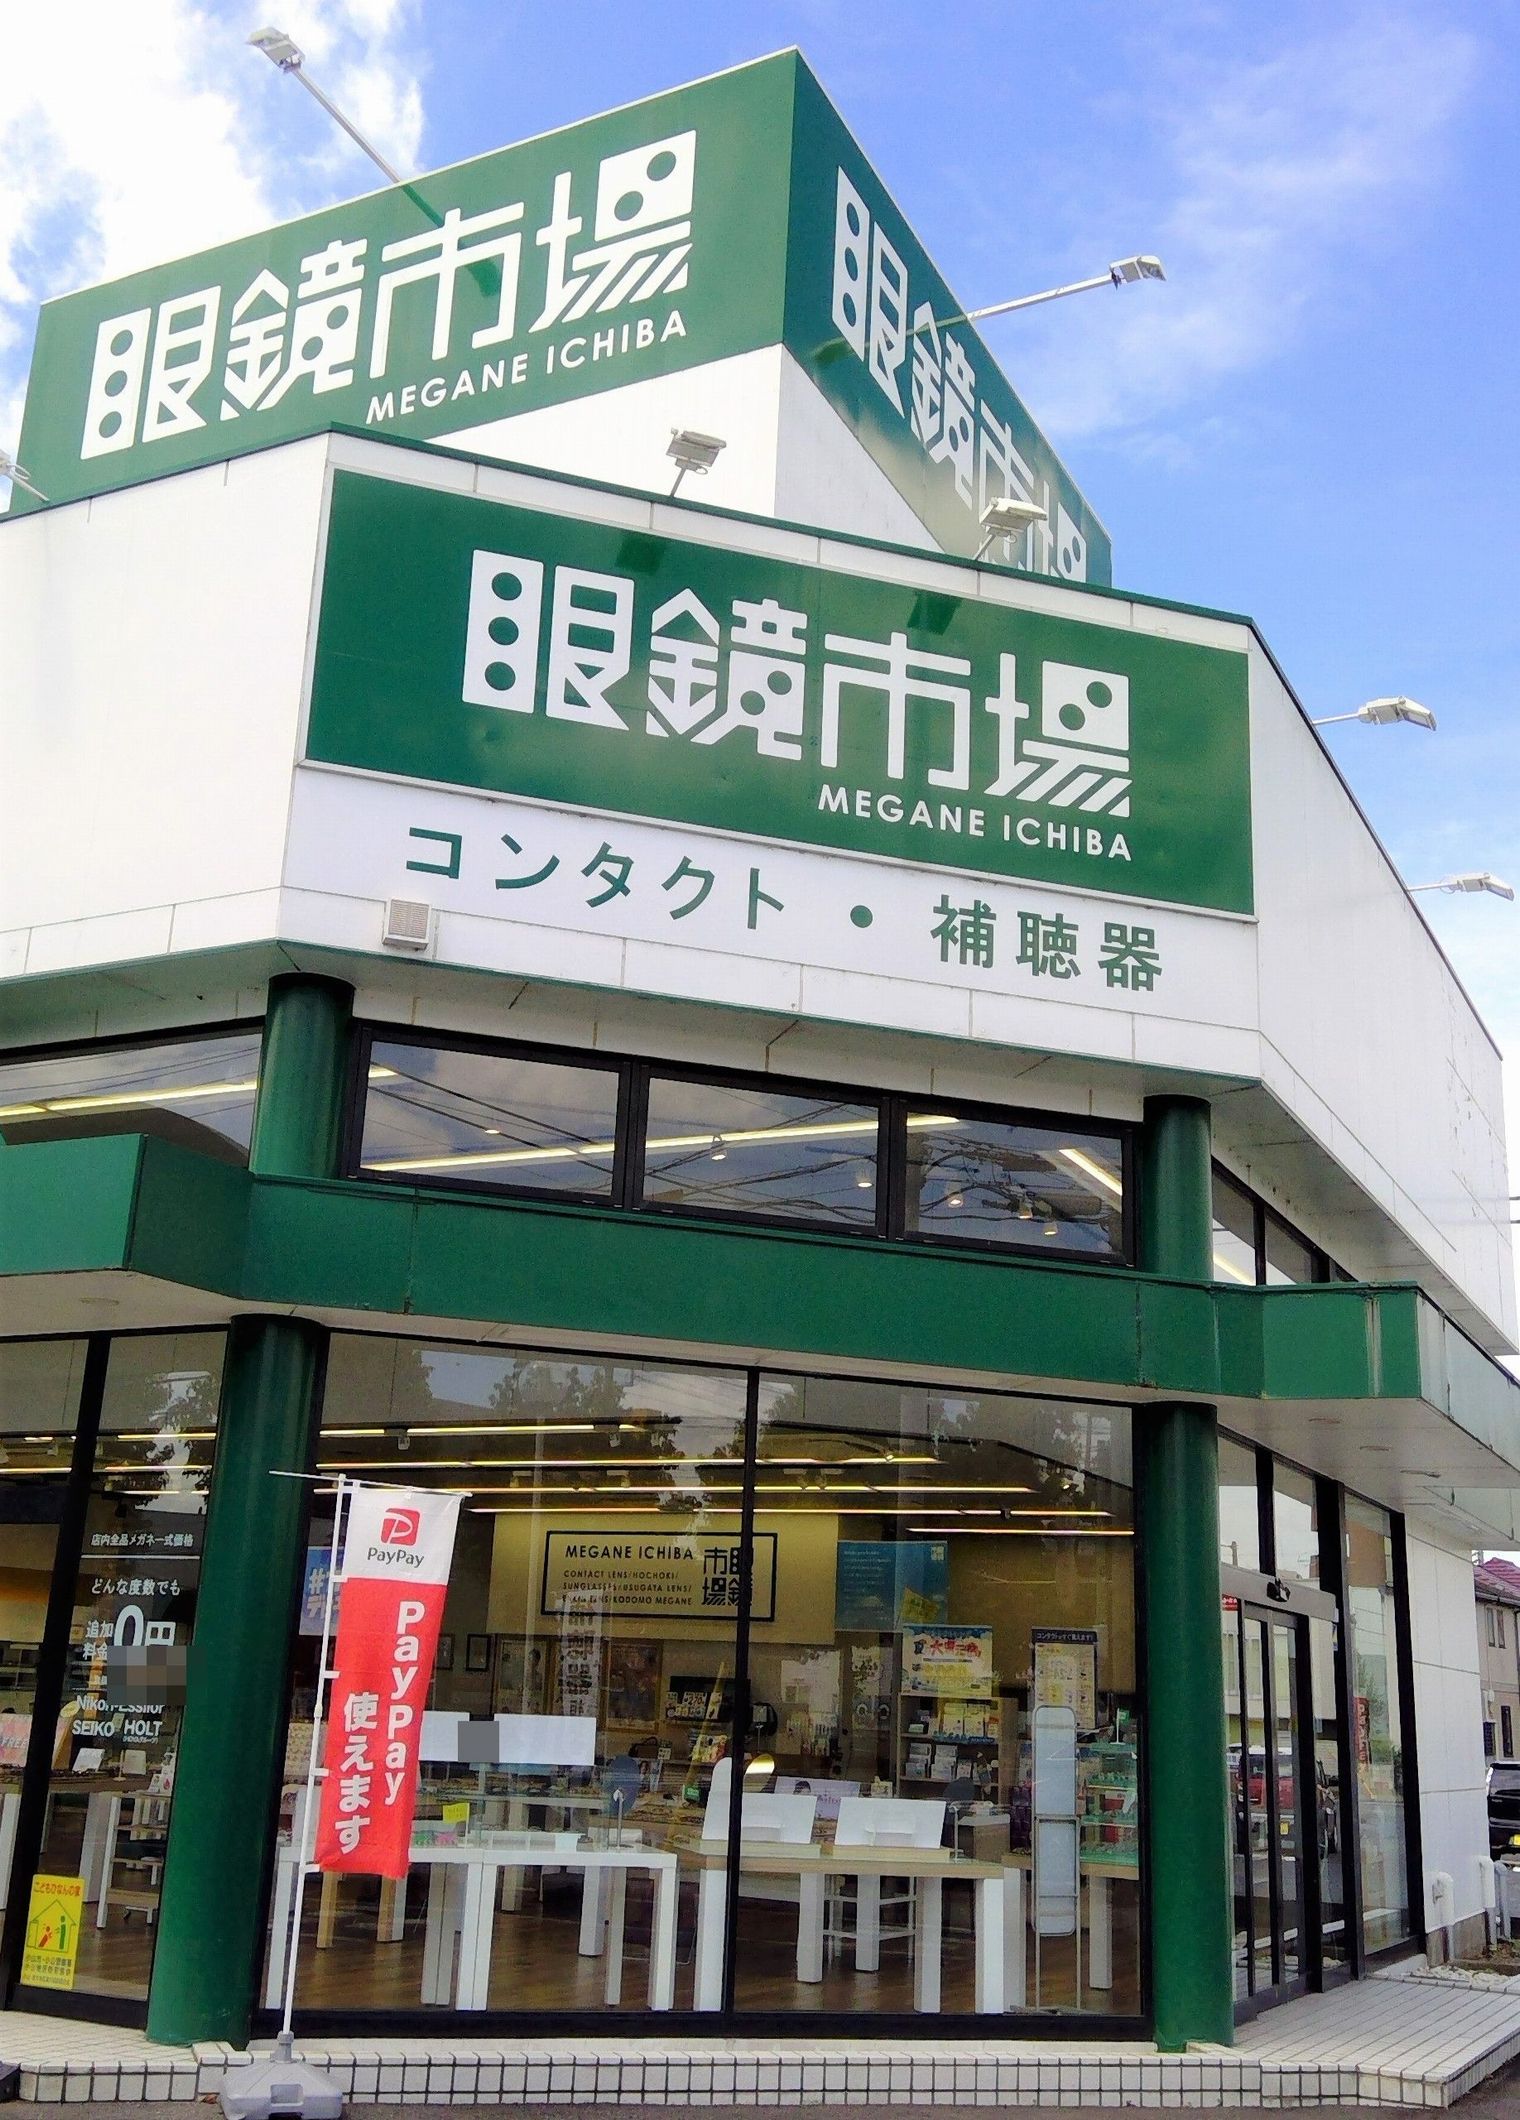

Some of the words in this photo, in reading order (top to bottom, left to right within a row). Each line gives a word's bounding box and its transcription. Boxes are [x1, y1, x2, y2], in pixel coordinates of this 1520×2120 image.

[80, 129, 697, 460] 眼鏡市場
[365, 353, 529, 425] MEGANE
[546, 310, 688, 375] ICHIBA
[461, 549, 1132, 818] 眼鏡市場
[817, 786, 985, 839] MEGANE
[1002, 814, 1131, 862] ICHIBA
[90, 1533, 194, 1548] 店内全品メガネ一式価格
[367, 1547, 424, 1569] PayPay
[564, 1545, 633, 1560] MEGANE
[638, 1545, 694, 1561] ICHIBA
[563, 1569, 604, 1579] CONTACT
[91, 1578, 181, 1596] どんな度数でも
[655, 1596, 693, 1607] MEGANE
[85, 1619, 115, 1639] 追加
[82, 1641, 108, 1660] 料金
[384, 1600, 426, 1805] PayPay
[72, 1719, 116, 1738] SEIKO
[123, 1719, 163, 1737] HOLT
[334, 1691, 379, 1854] 使えます
